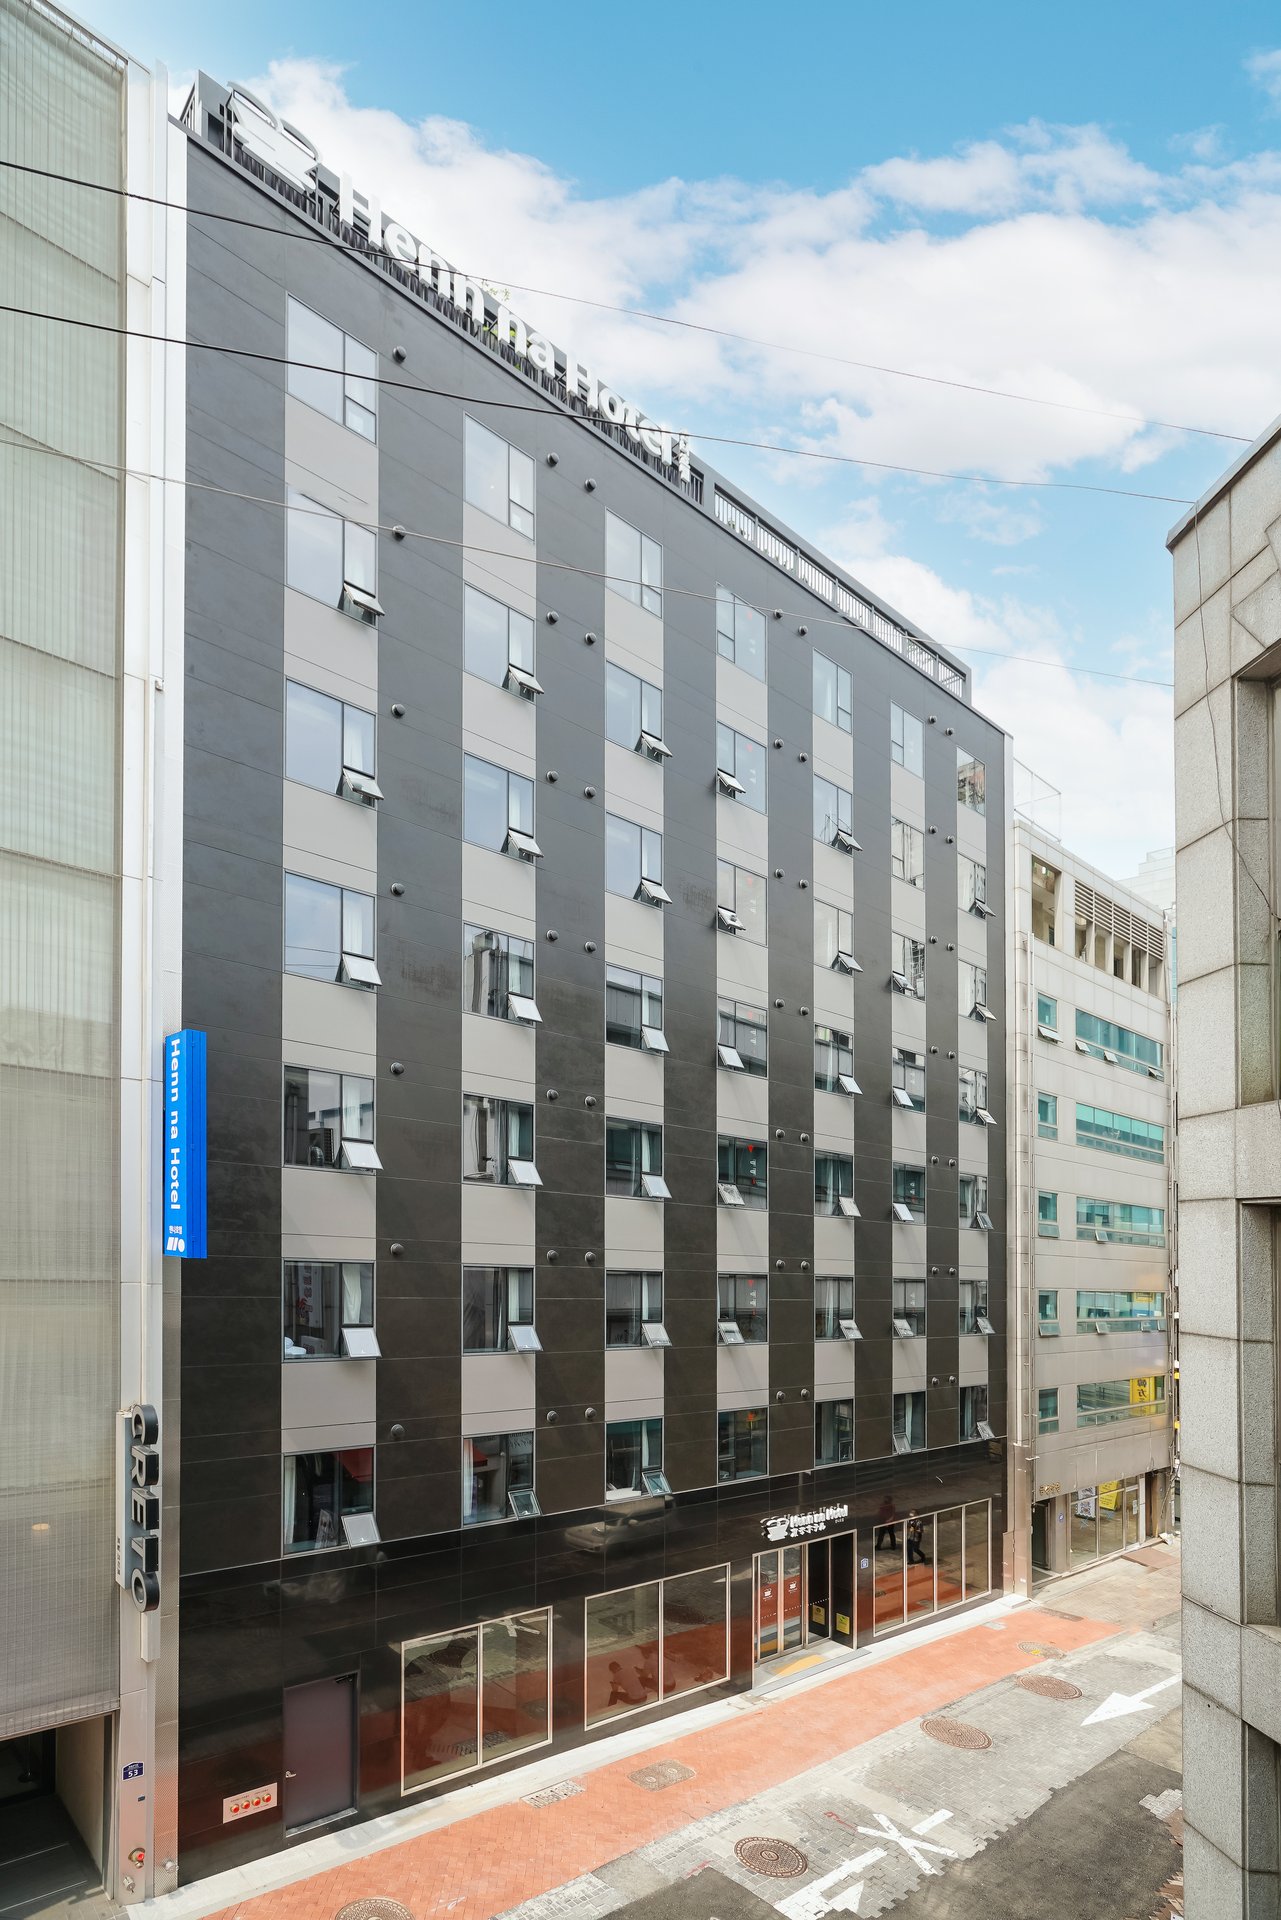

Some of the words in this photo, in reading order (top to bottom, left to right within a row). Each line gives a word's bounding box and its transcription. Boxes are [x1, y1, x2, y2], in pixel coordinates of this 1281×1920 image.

[339, 170, 484, 324] Henn
[498, 304, 556, 377] na
[566, 352, 673, 466] Hotel
[170, 1038, 180, 1102] Henn
[170, 1110, 178, 1139] na
[170, 1147, 181, 1210] Hotel
[131, 1404, 160, 1613] CRETO
[128, 1769, 139, 1778] 53
